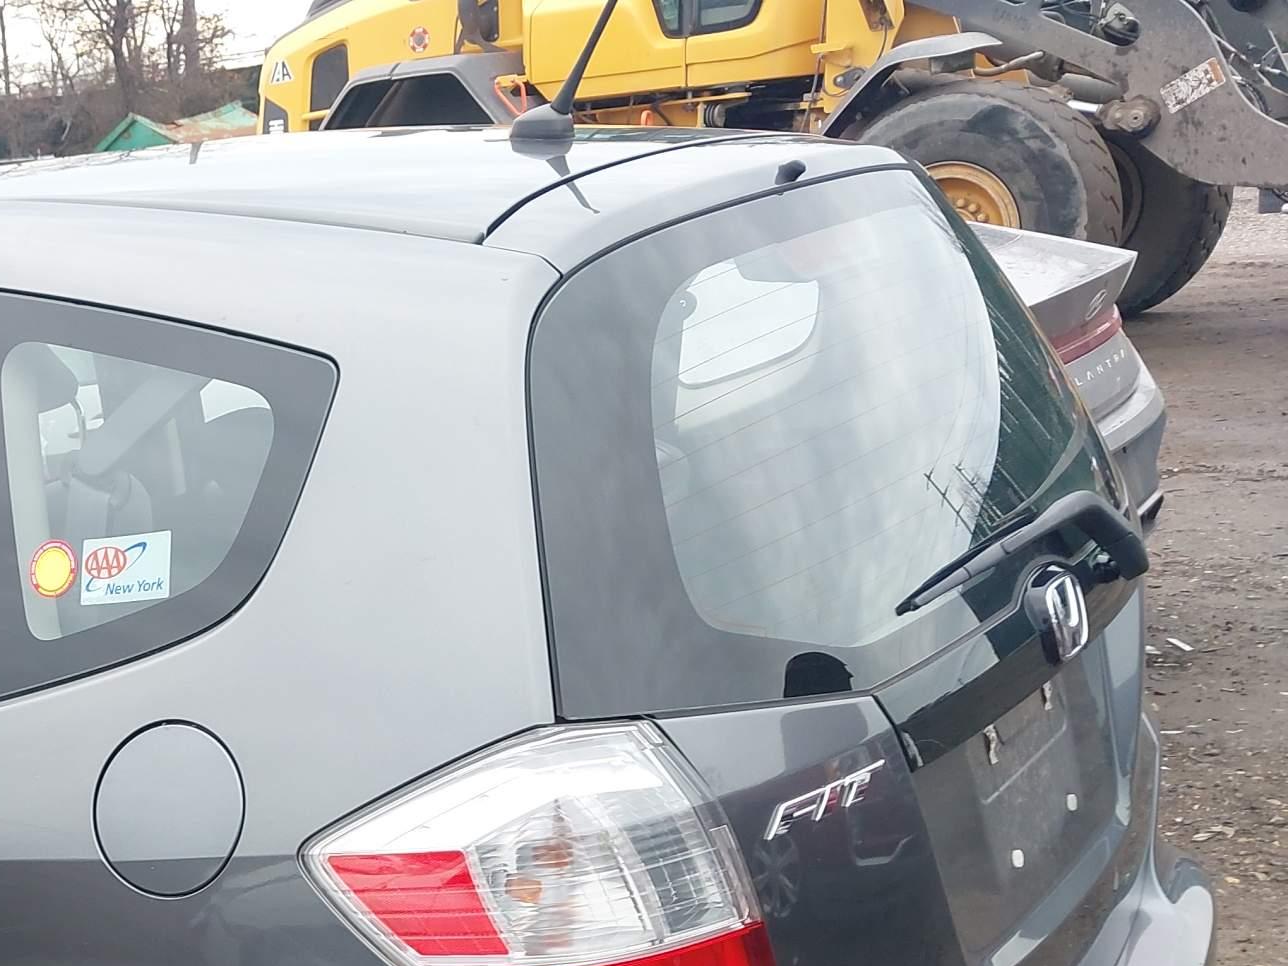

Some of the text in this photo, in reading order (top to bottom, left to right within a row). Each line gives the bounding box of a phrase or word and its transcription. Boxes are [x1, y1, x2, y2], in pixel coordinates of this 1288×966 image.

[88, 547, 123, 578] AAA
[105, 577, 165, 595] New York
[763, 758, 886, 841] FIT
